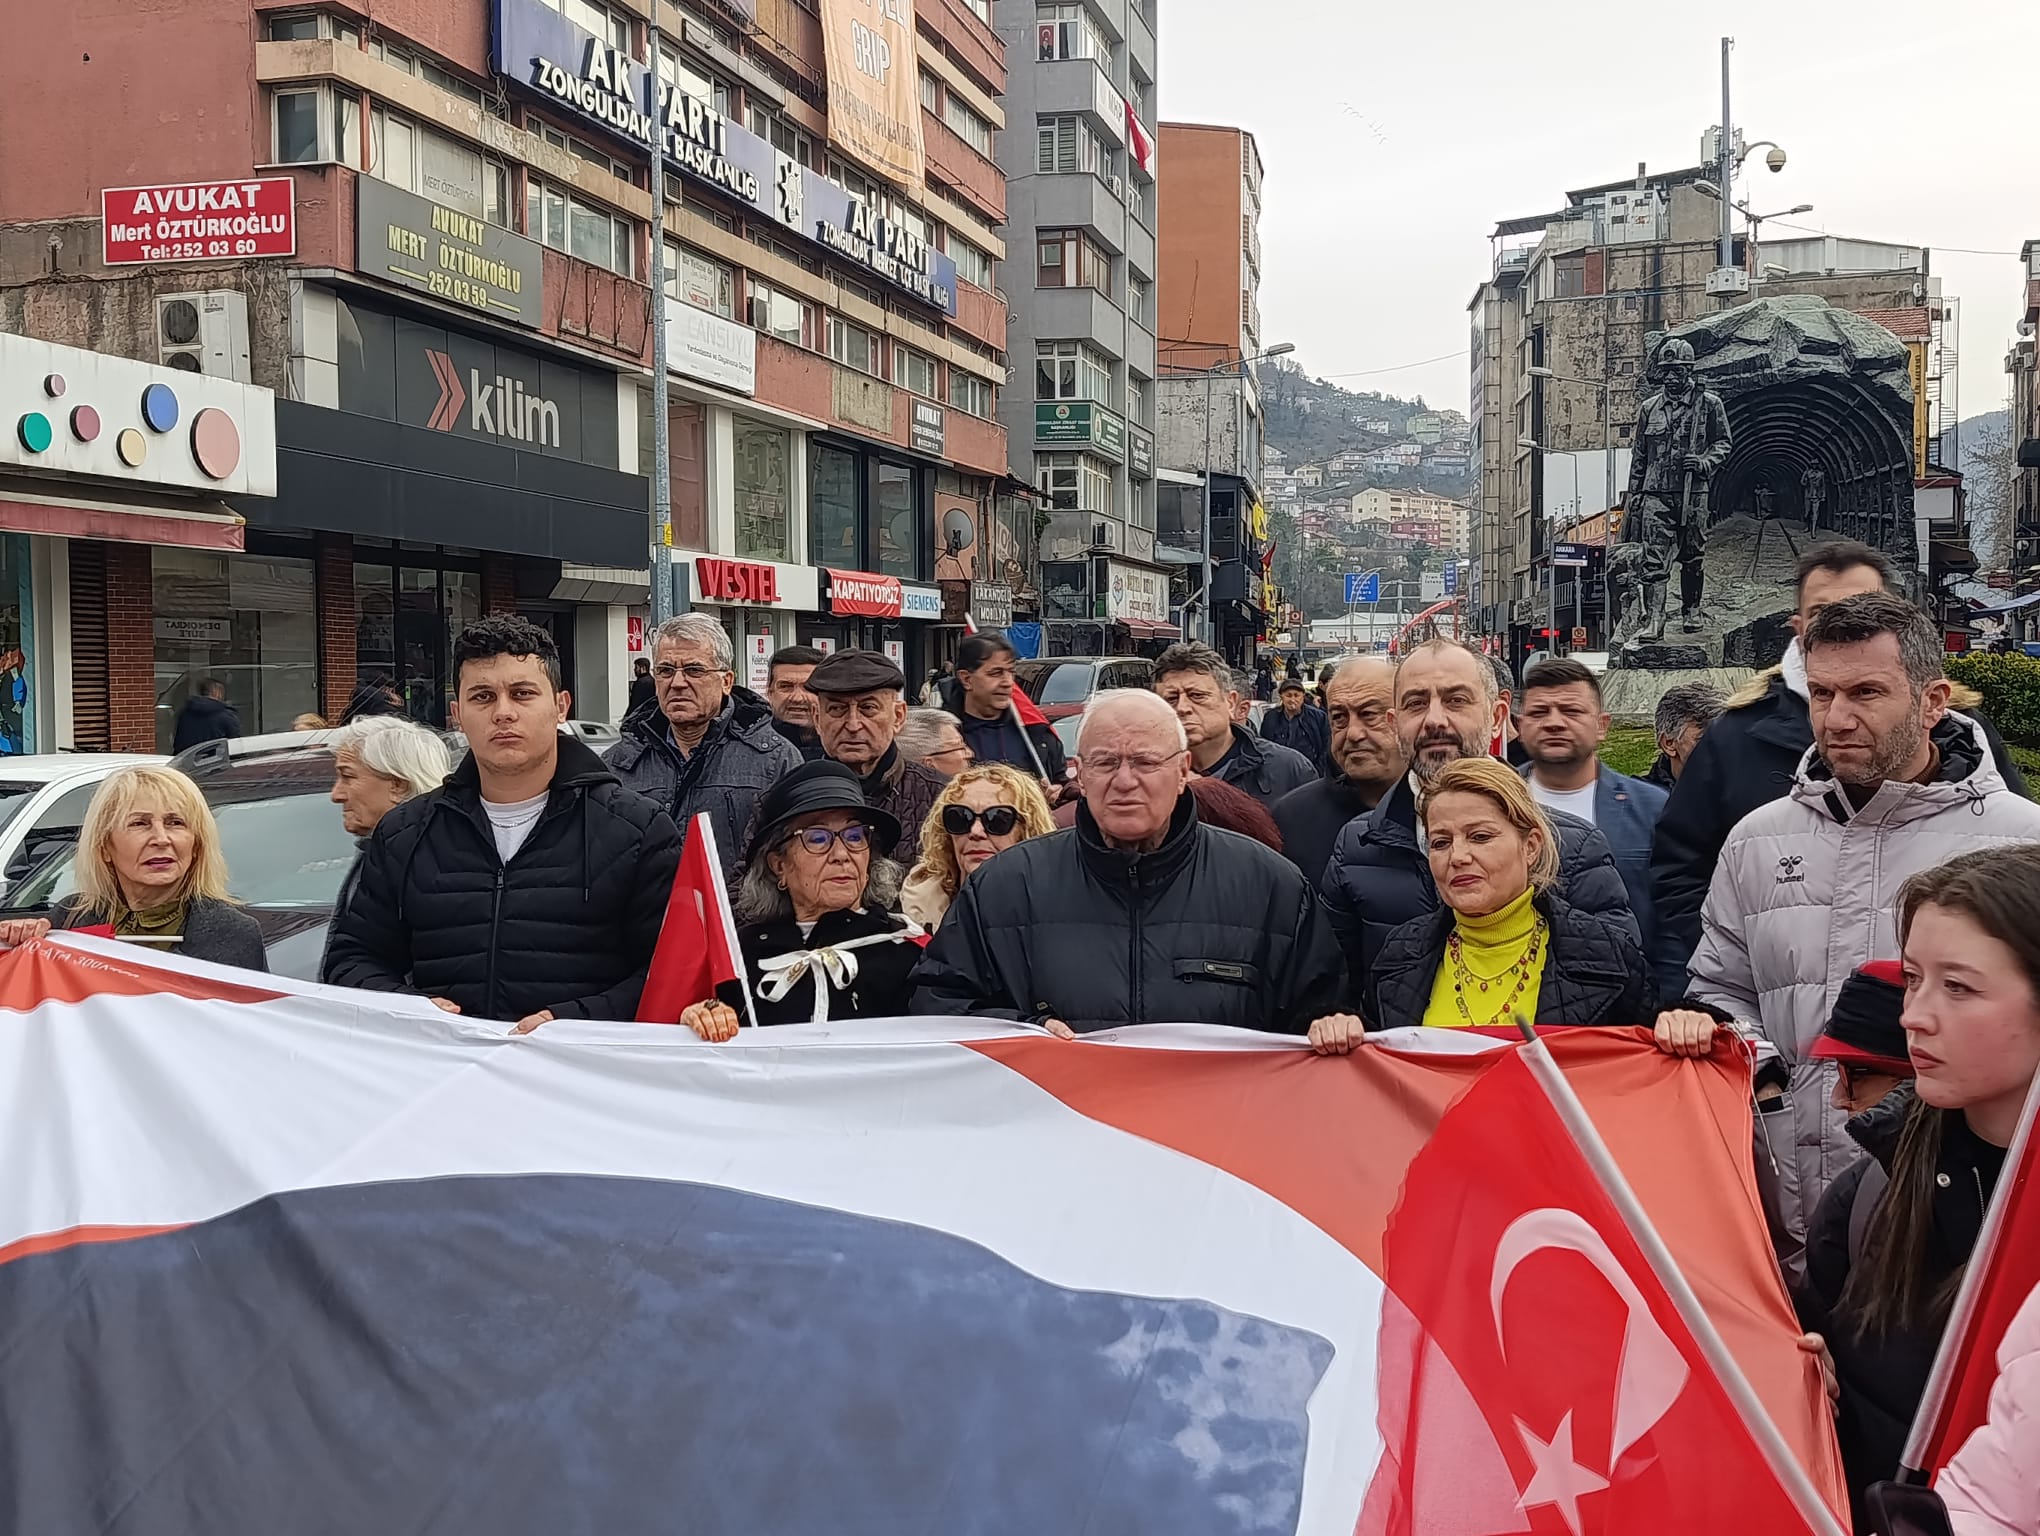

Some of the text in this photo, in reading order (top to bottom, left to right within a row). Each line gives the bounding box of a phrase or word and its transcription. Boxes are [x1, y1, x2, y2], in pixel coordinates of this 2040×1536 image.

[585, 37, 636, 104] AK
[851, 17, 891, 87] GRUP
[537, 56, 653, 144] ZONGULDAK
[674, 135, 760, 203] BAŞKANLIĞI
[132, 184, 262, 215] AVUKAT
[111, 211, 286, 243] Mert ÖZTÜRKOĞLU
[431, 204, 485, 247] AVUKAT
[823, 220, 870, 265] ZONGULDAK
[851, 199, 878, 247] AK
[208, 240, 229, 255] 03
[235, 239, 257, 254] 60
[387, 223, 521, 294] MERT ÖZTÜRKOĞLU
[427, 270, 488, 308] 252 03 59
[687, 314, 753, 360] CANSUYU
[471, 368, 560, 448] kilim
[916, 403, 941, 427] AVUKAT
[699, 557, 782, 603] VESTEL
[833, 578, 899, 605] KAPATIYORUZ
[906, 593, 939, 613] SIEMENS
[1775, 871, 1805, 885] hummel
